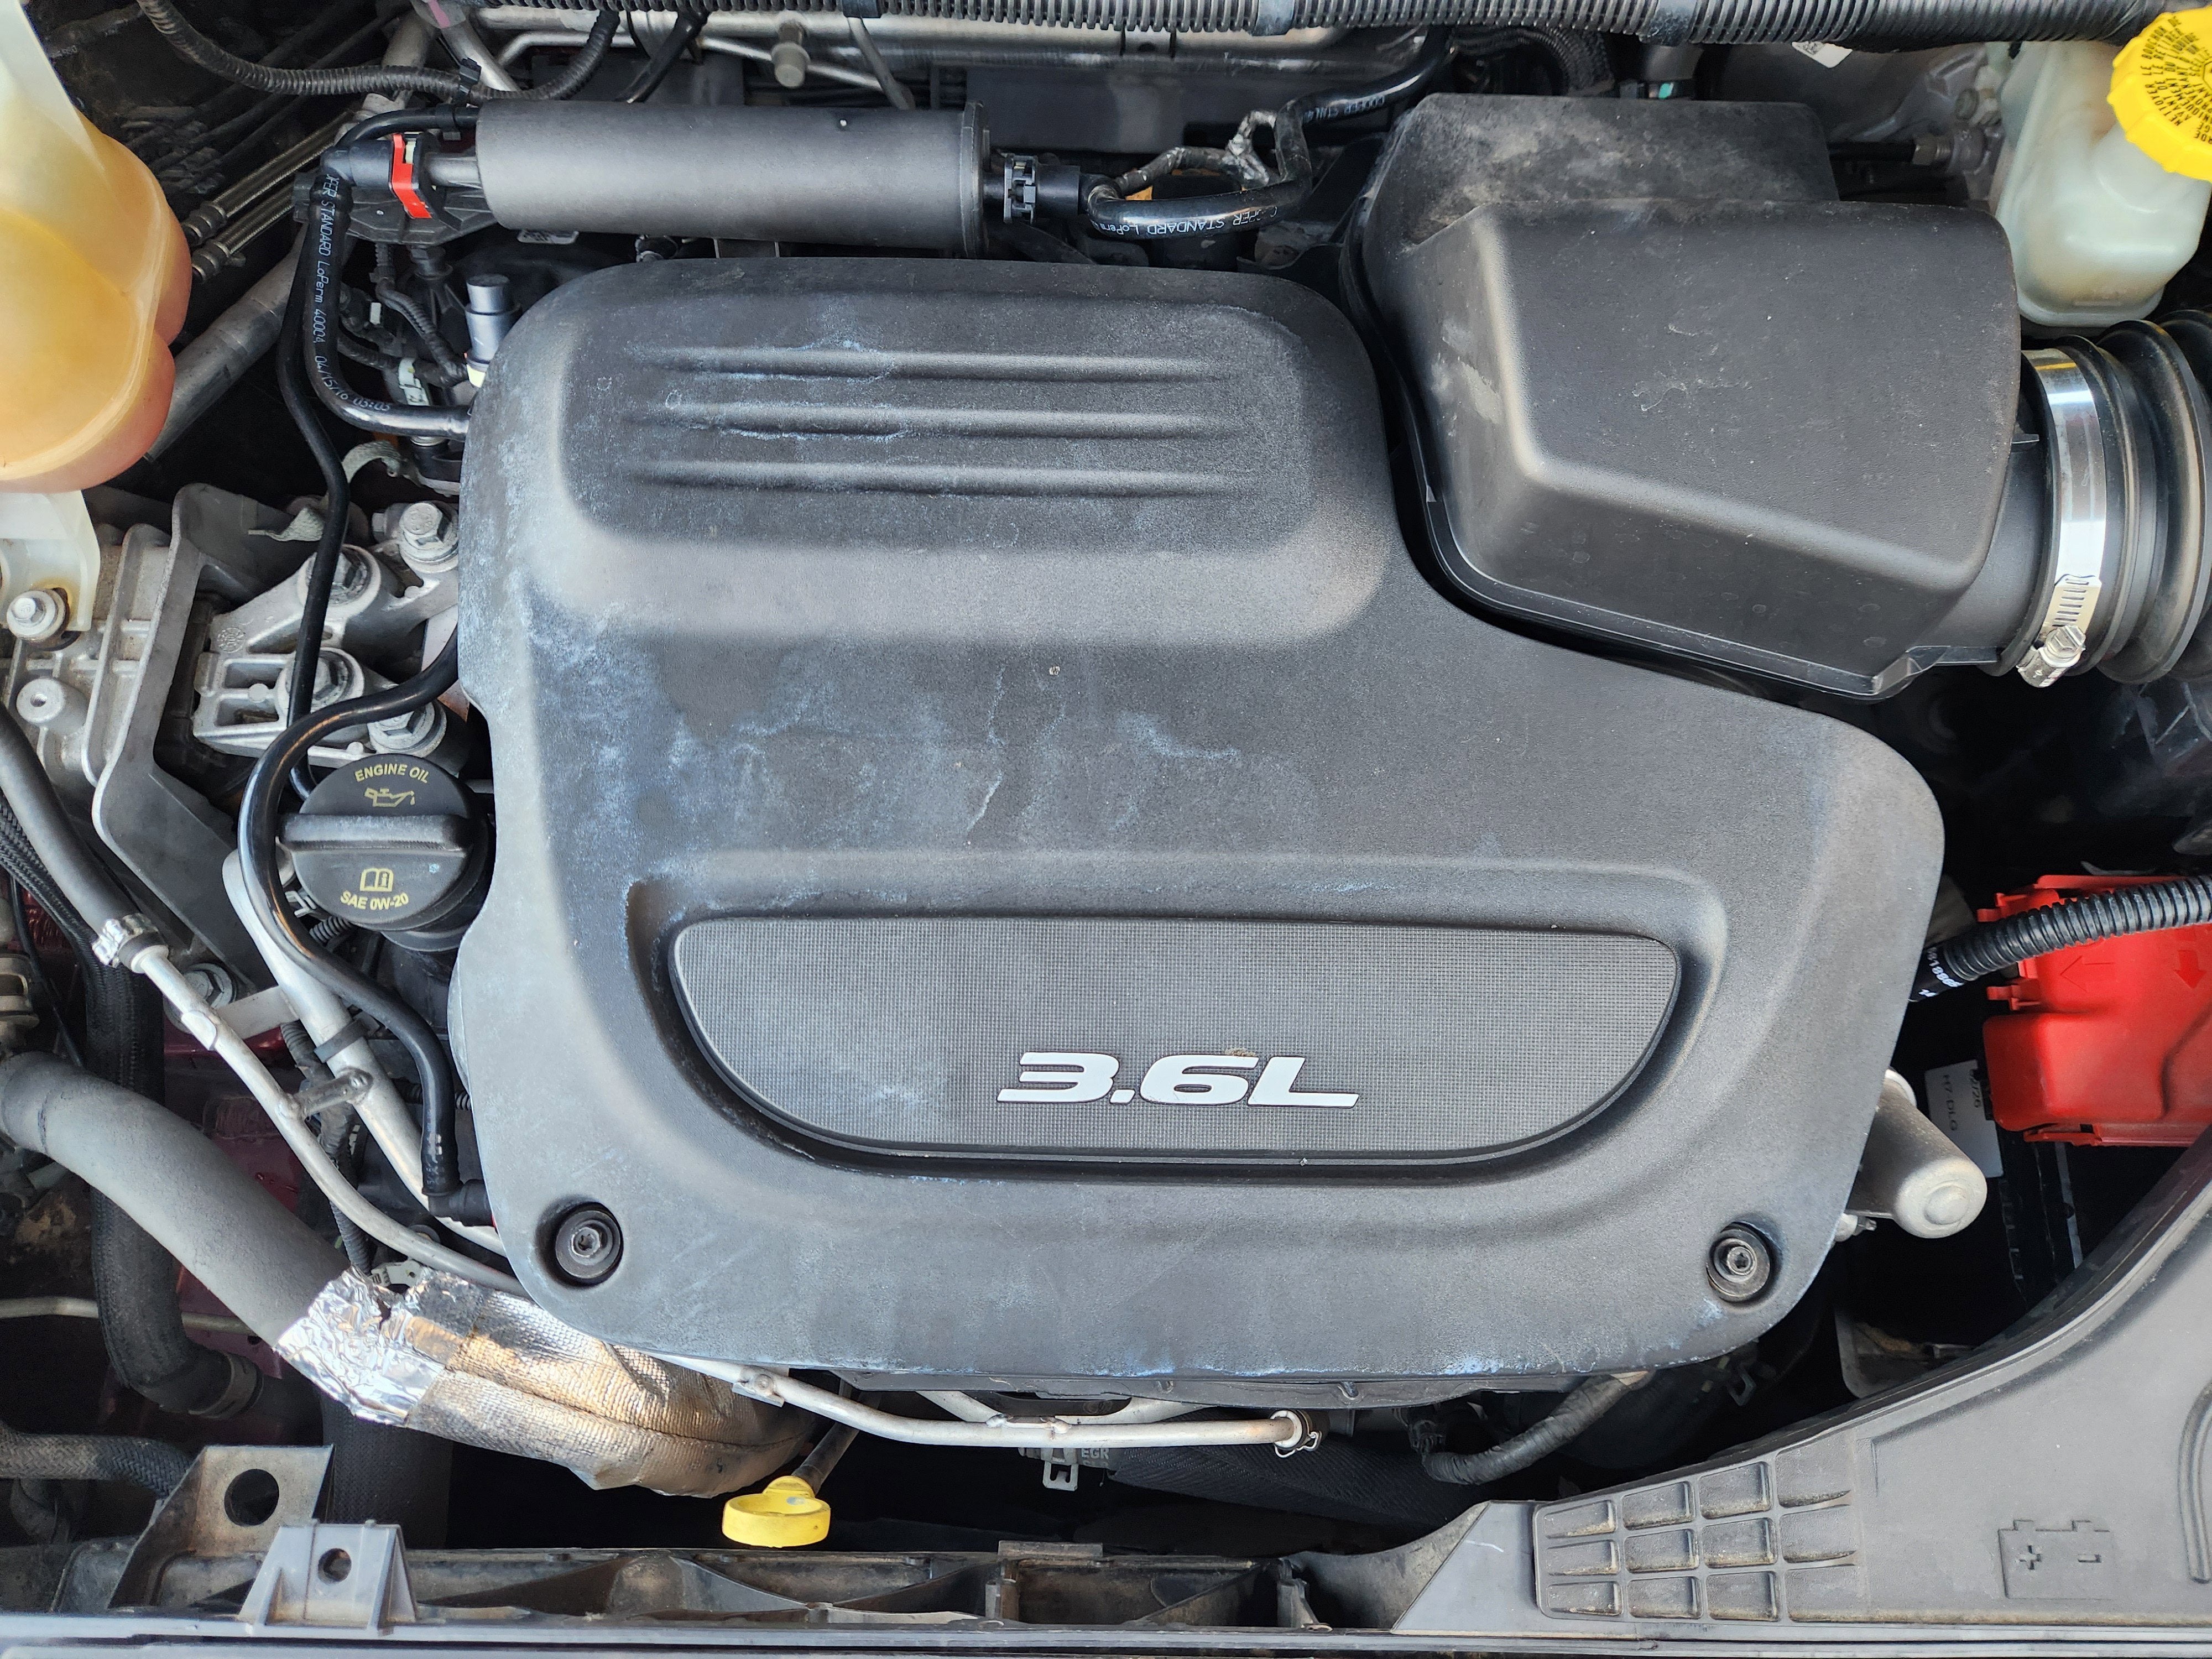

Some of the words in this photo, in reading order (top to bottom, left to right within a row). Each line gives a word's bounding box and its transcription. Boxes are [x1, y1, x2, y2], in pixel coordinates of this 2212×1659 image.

[2141, 26, 2166, 59] BOUCHON
[2153, 28, 2184, 60] RETIRER
[2140, 65, 2152, 75] LE
[2152, 64, 2164, 74] LE
[2154, 80, 2168, 90] DE
[2145, 84, 2183, 126] NETTOYER
[2163, 95, 2192, 121] AVANT
[319, 200, 335, 257] STANDARD
[1100, 223, 1139, 236] LoPerm
[1147, 216, 1225, 235] STANDARD
[315, 260, 330, 303] LoPerm
[354, 763, 408, 782] ENGINE
[409, 766, 429, 784] OIL
[340, 890, 368, 910] SAE
[369, 892, 409, 910] 0W-20
[997, 1051, 1360, 1108] 3.6L
[1081, 1448, 1109, 1460] EGR
